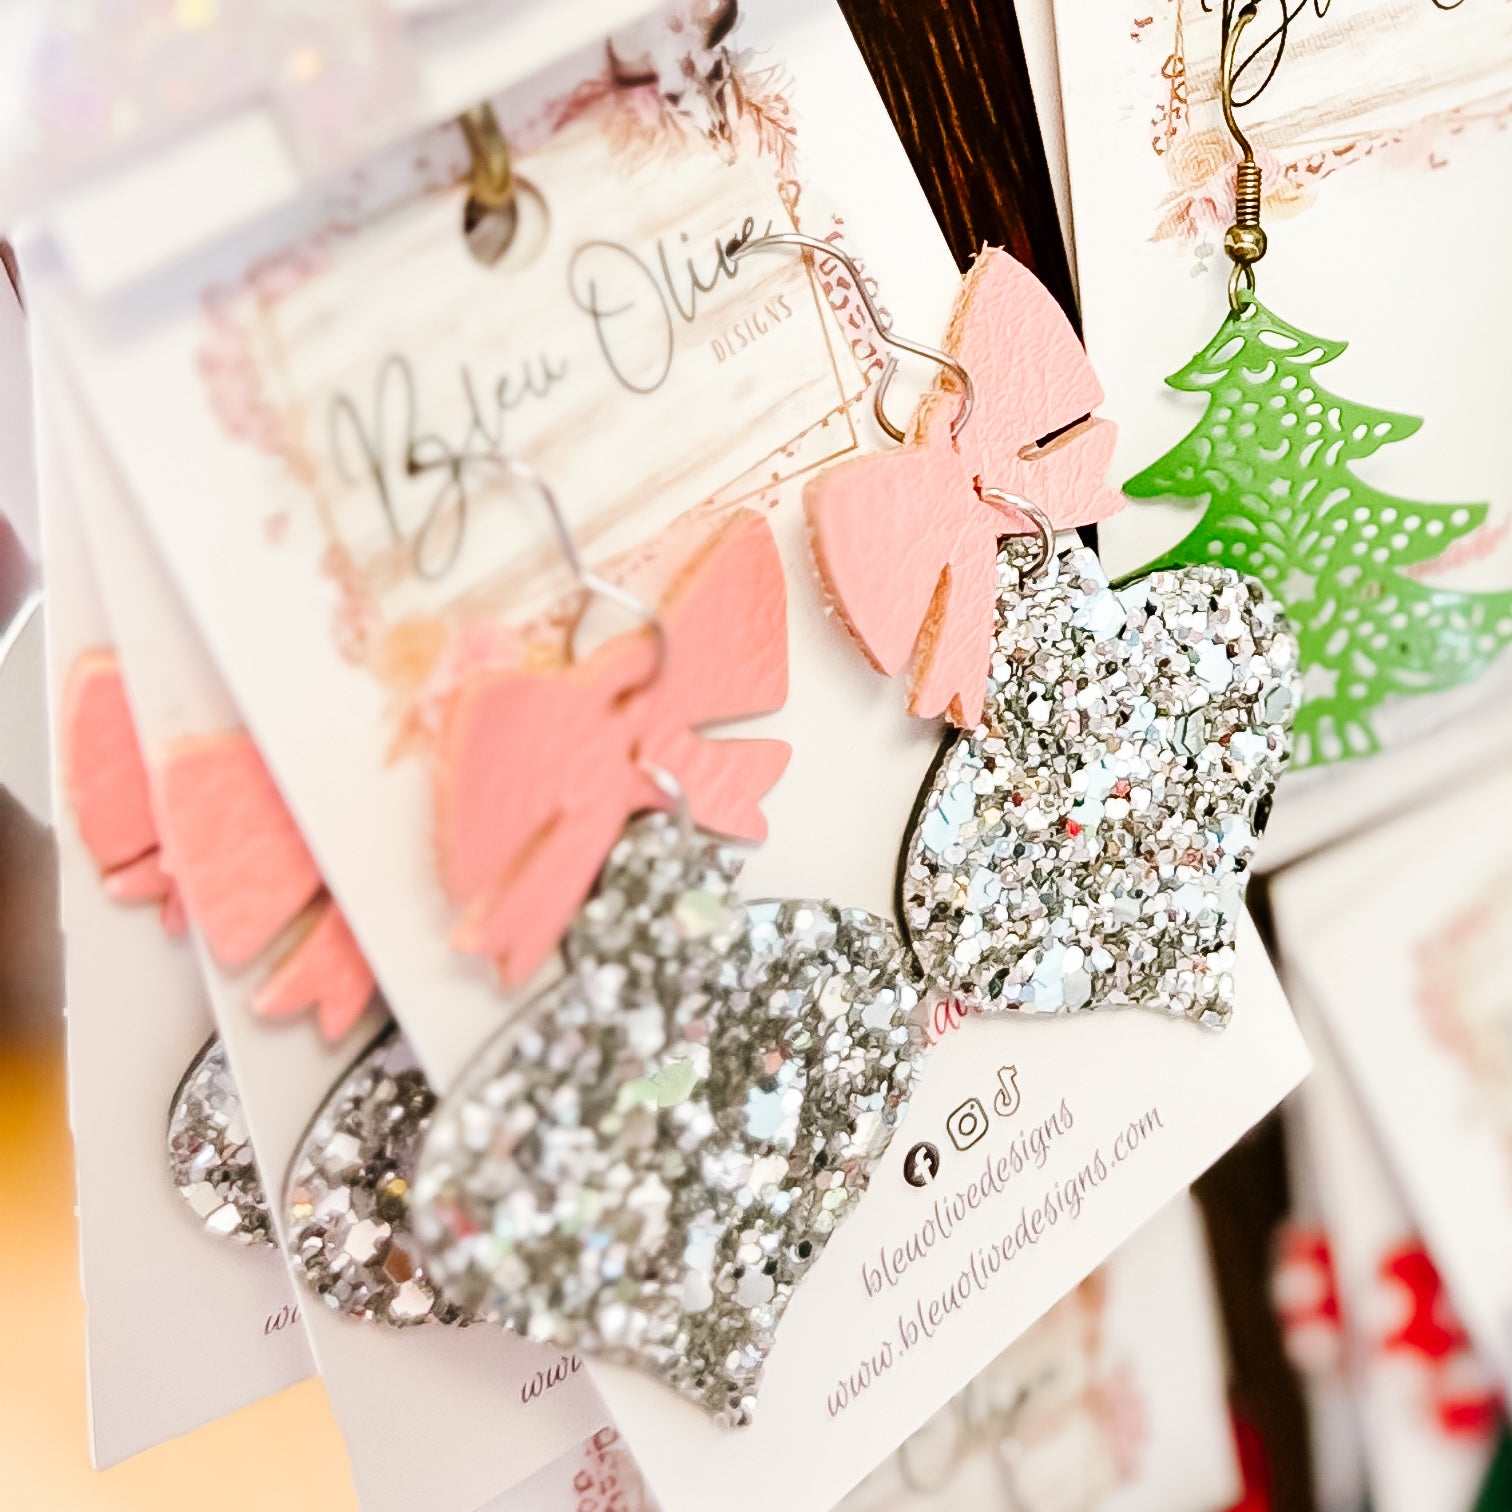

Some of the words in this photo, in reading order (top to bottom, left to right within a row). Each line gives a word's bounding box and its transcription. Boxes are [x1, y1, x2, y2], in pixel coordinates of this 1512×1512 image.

[328, 353, 568, 581] Bleu
[568, 216, 773, 394] Olive
[711, 294, 793, 363] DESIGNS
[827, 1107, 1164, 1417] www.bleuolivedesigns.com
[861, 1097, 1074, 1298] bleuolivedesigns
